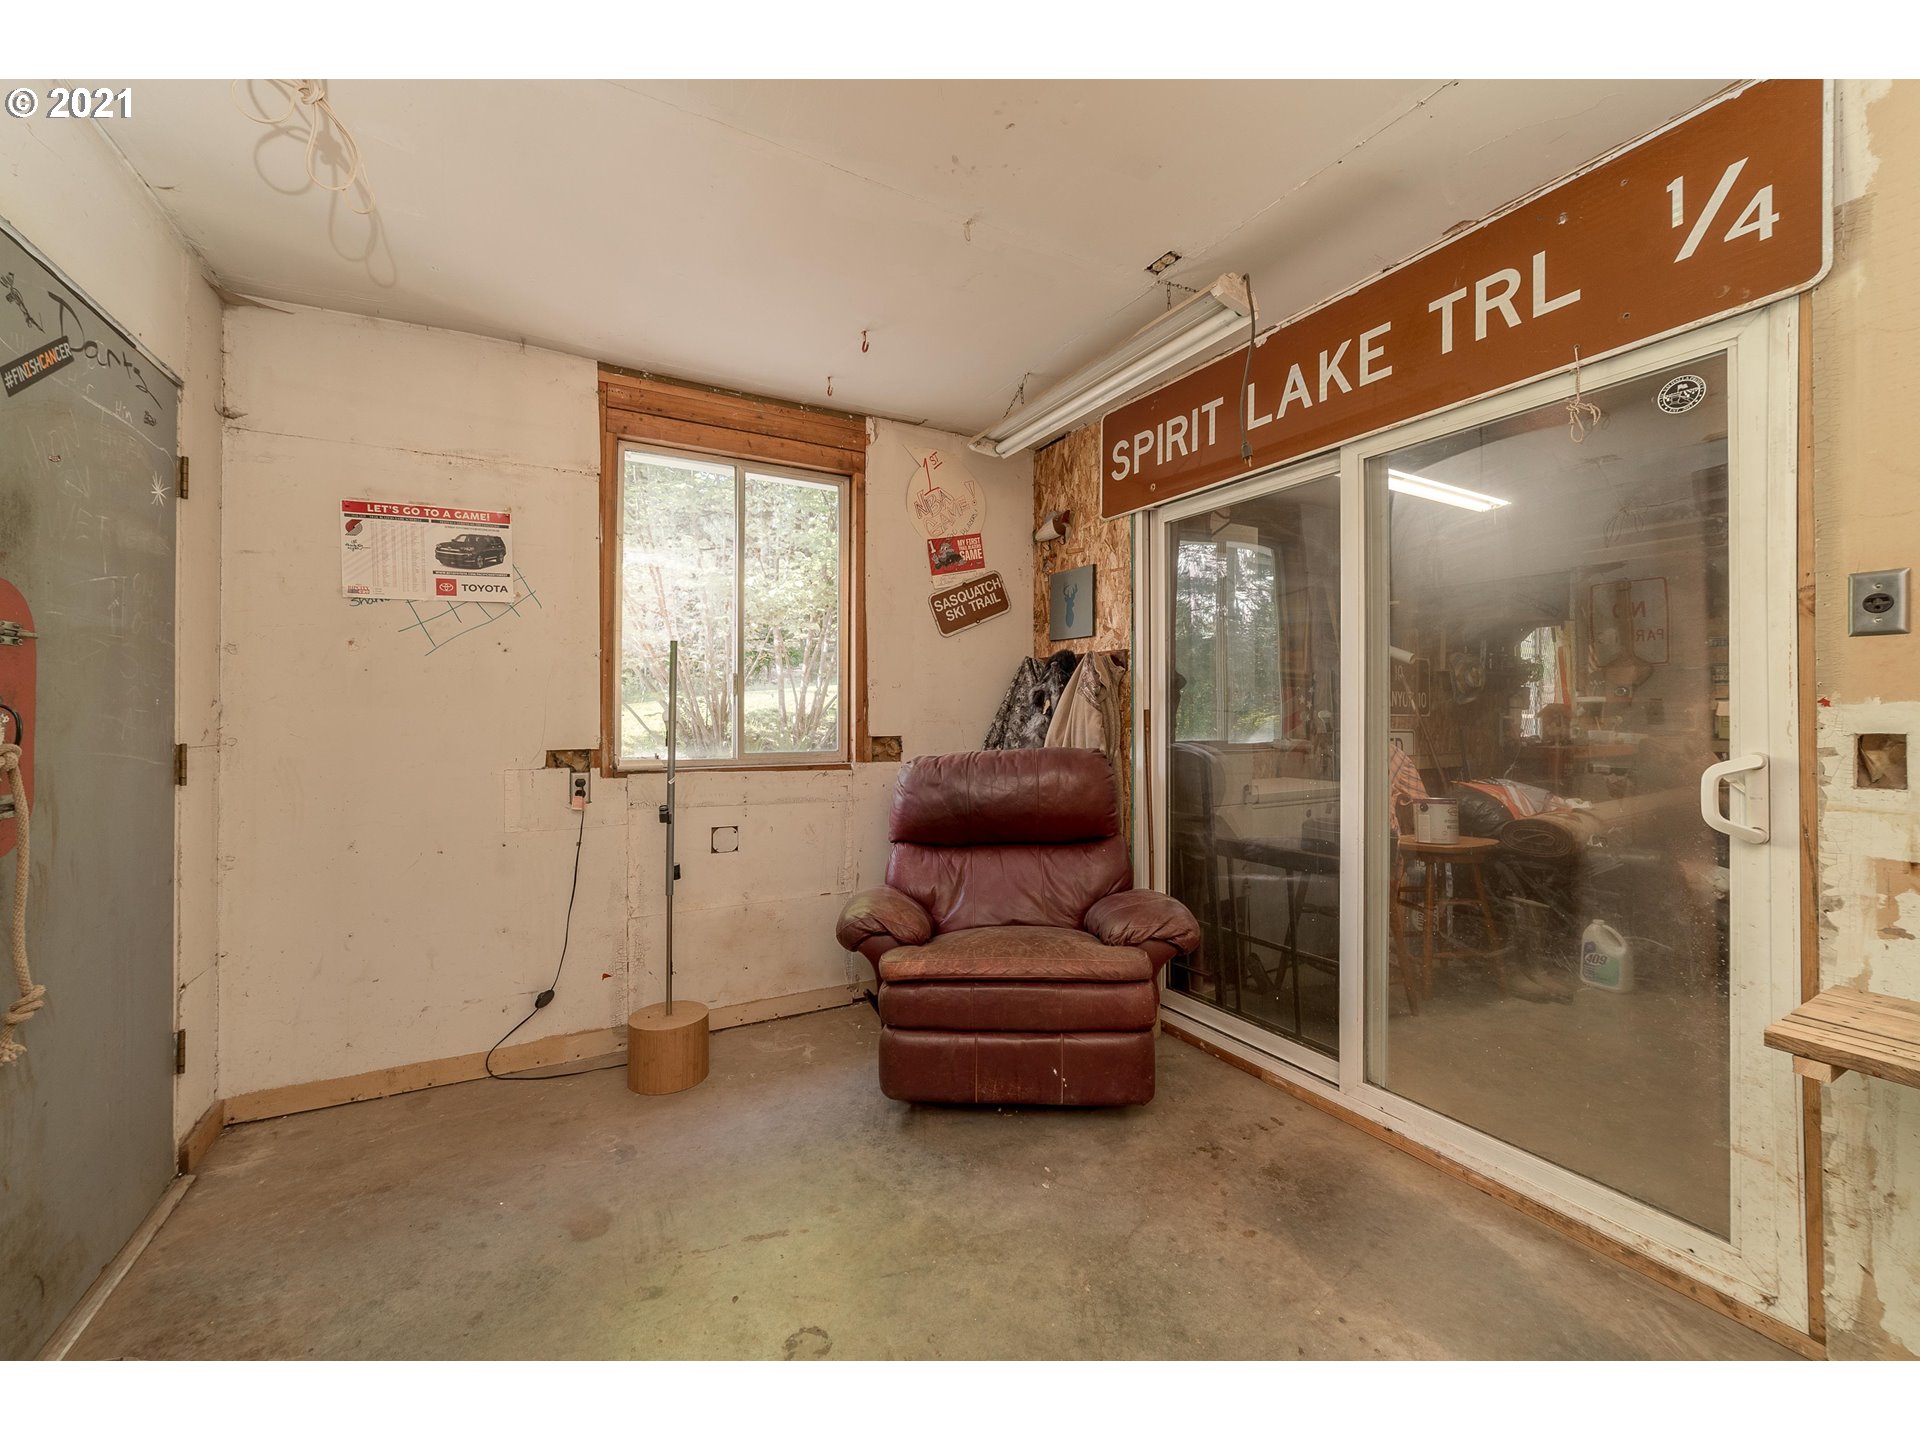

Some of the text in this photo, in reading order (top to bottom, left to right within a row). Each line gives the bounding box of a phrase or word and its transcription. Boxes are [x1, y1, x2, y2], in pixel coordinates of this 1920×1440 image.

[1111, 156, 1780, 481] SPIRIT LAKE TRL 1/4
[4, 342, 73, 389] #FINISHCANCER
[367, 503, 490, 521] LET'S GO TO A GAME!
[957, 537, 980, 547] MY FIRST
[461, 584, 508, 593] TOYOTA
[934, 577, 1002, 612] SASQUATCH
[945, 592, 1002, 621] SKI TRAIL
[1585, 953, 1608, 967] 409
